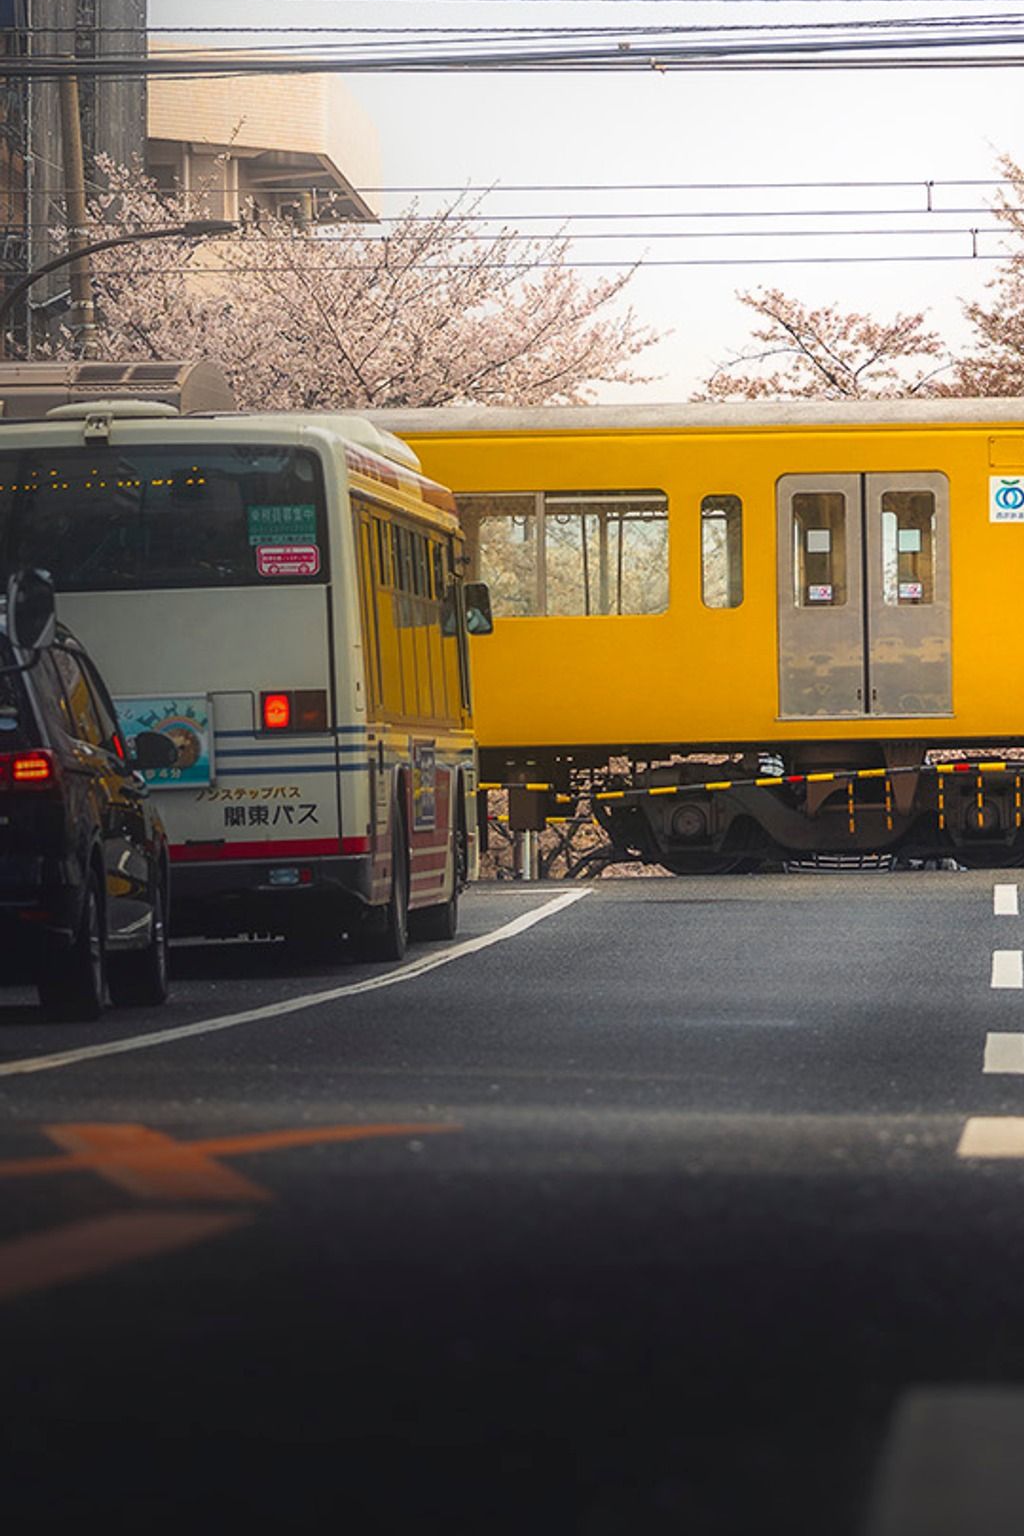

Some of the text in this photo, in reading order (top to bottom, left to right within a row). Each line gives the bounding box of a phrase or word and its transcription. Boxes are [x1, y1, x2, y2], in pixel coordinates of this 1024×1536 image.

[196, 787, 300, 801] ノンステップバス
[224, 804, 318, 826] 関東バス
